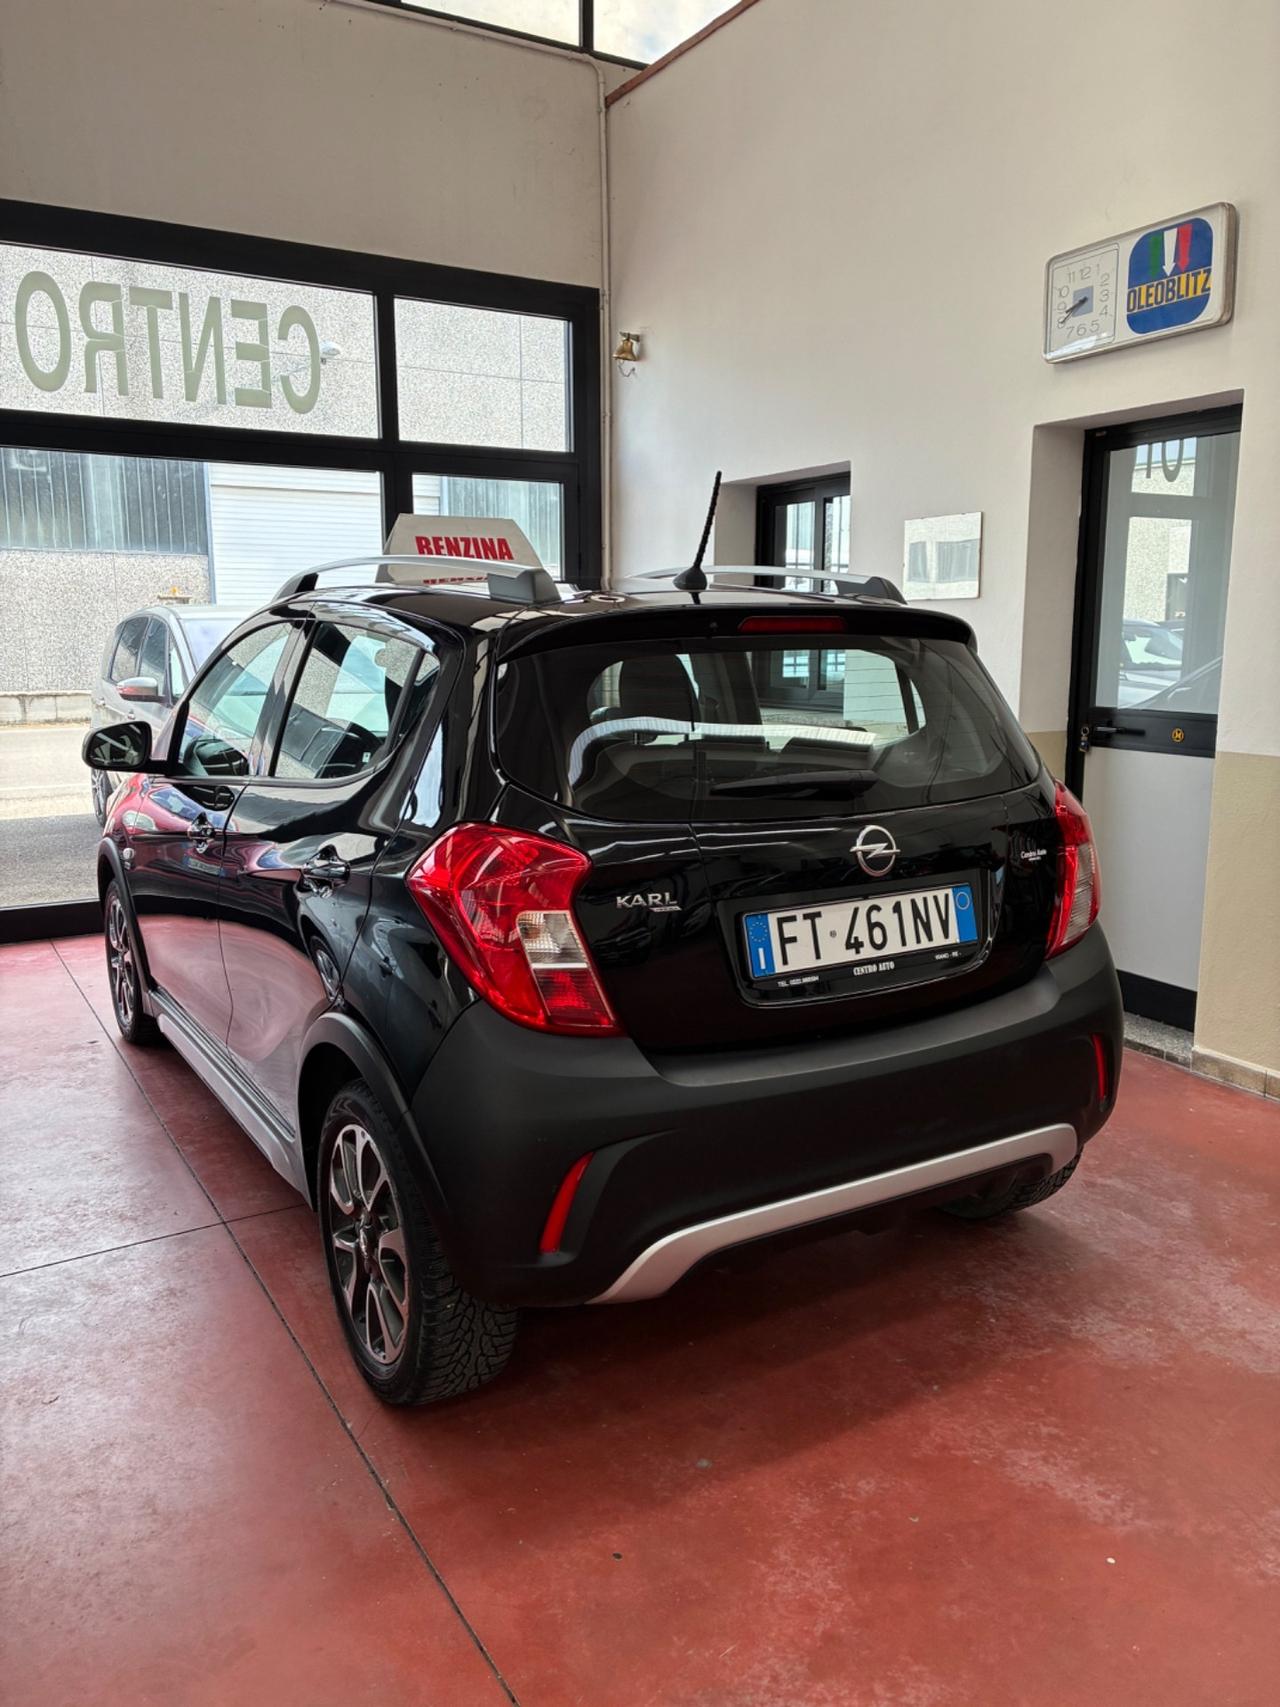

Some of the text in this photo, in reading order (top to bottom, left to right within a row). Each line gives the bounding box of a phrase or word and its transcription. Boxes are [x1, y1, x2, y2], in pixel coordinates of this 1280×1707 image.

[1067, 272, 1076, 283] 11
[1080, 266, 1091, 280] 12
[1100, 273, 1110, 286] 2
[1099, 289, 1110, 302] 3
[1127, 268, 1212, 312] OLEOBLITZ
[1099, 305, 1109, 317] 4
[1066, 326, 1075, 338] 7
[1077, 323, 1087, 336] 6
[1090, 319, 1100, 333] 5
[415, 536, 514, 560] BENZINA
[616, 892, 678, 909] KARL
[777, 911, 822, 965] FT
[845, 893, 950, 954] 461NV
